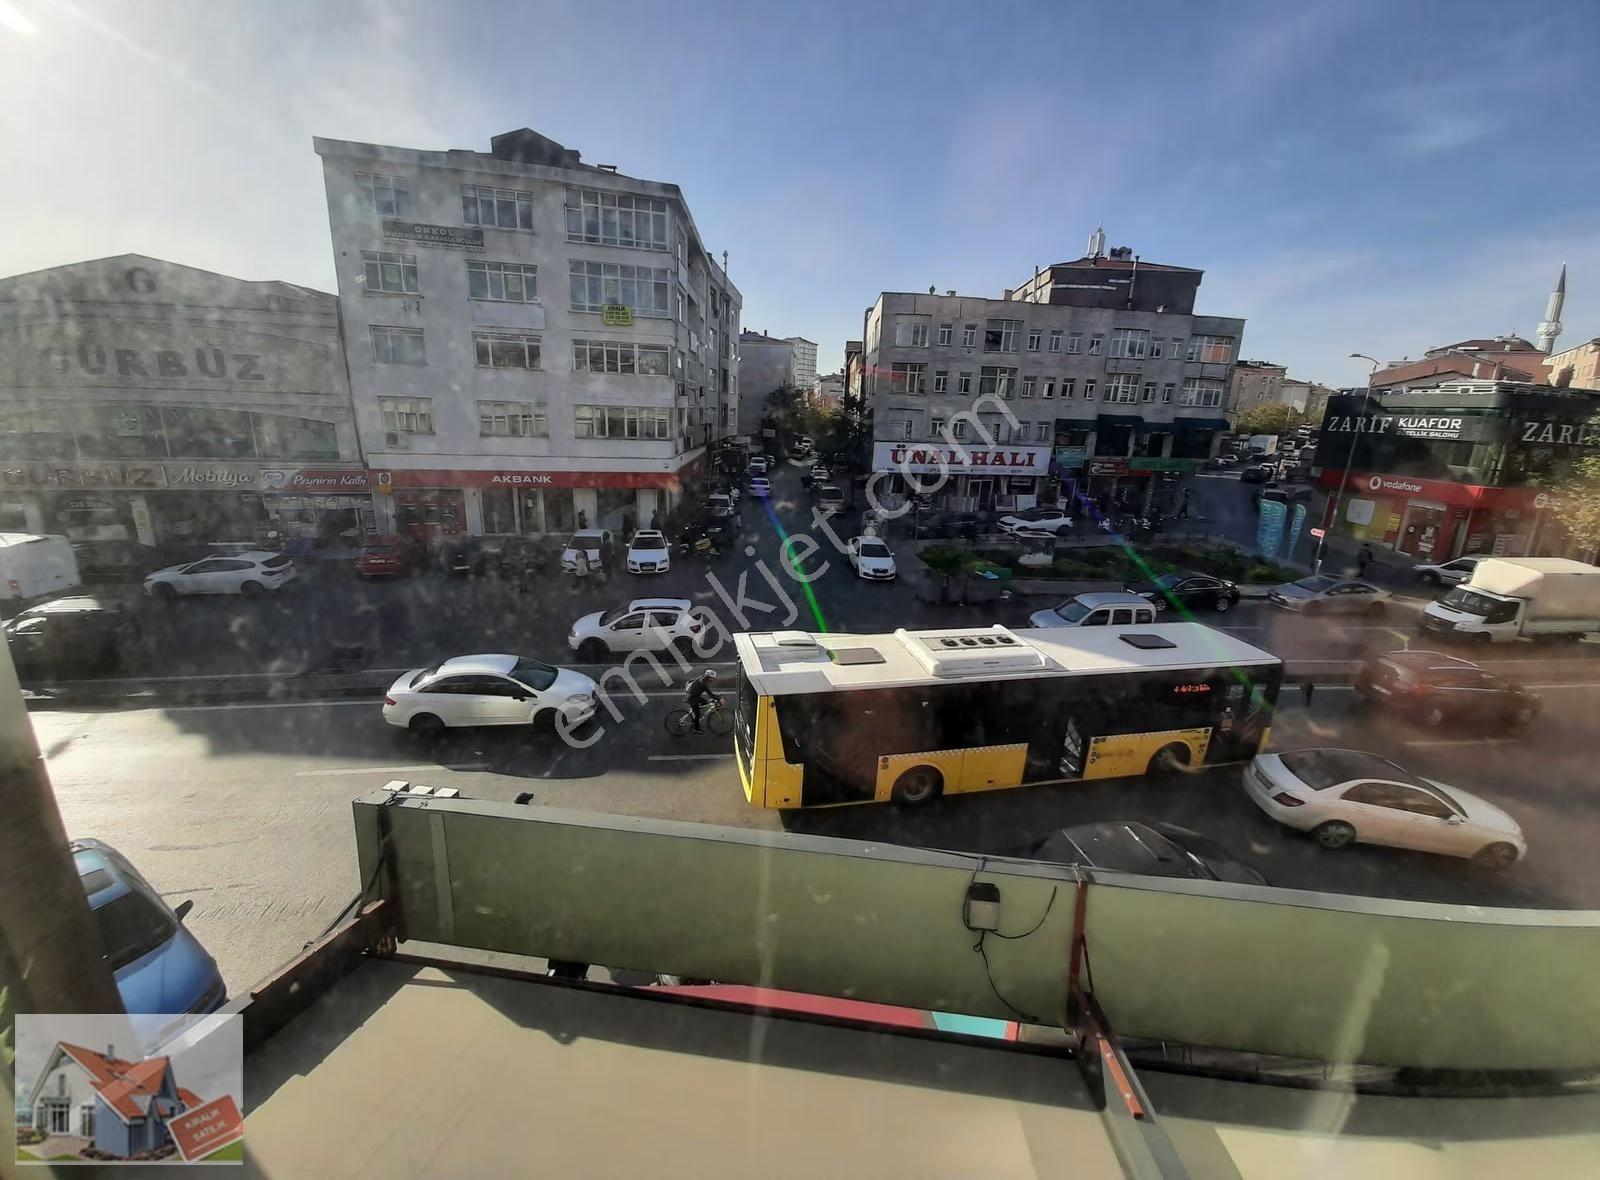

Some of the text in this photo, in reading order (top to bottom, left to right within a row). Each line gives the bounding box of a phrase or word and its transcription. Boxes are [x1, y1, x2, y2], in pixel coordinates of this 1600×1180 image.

[970, 451, 1036, 466] HALI
[171, 468, 253, 487] Mobilya
[293, 474, 337, 487] Peynirin
[492, 475, 552, 483] AKBANK
[1382, 480, 1422, 493] vodafone
